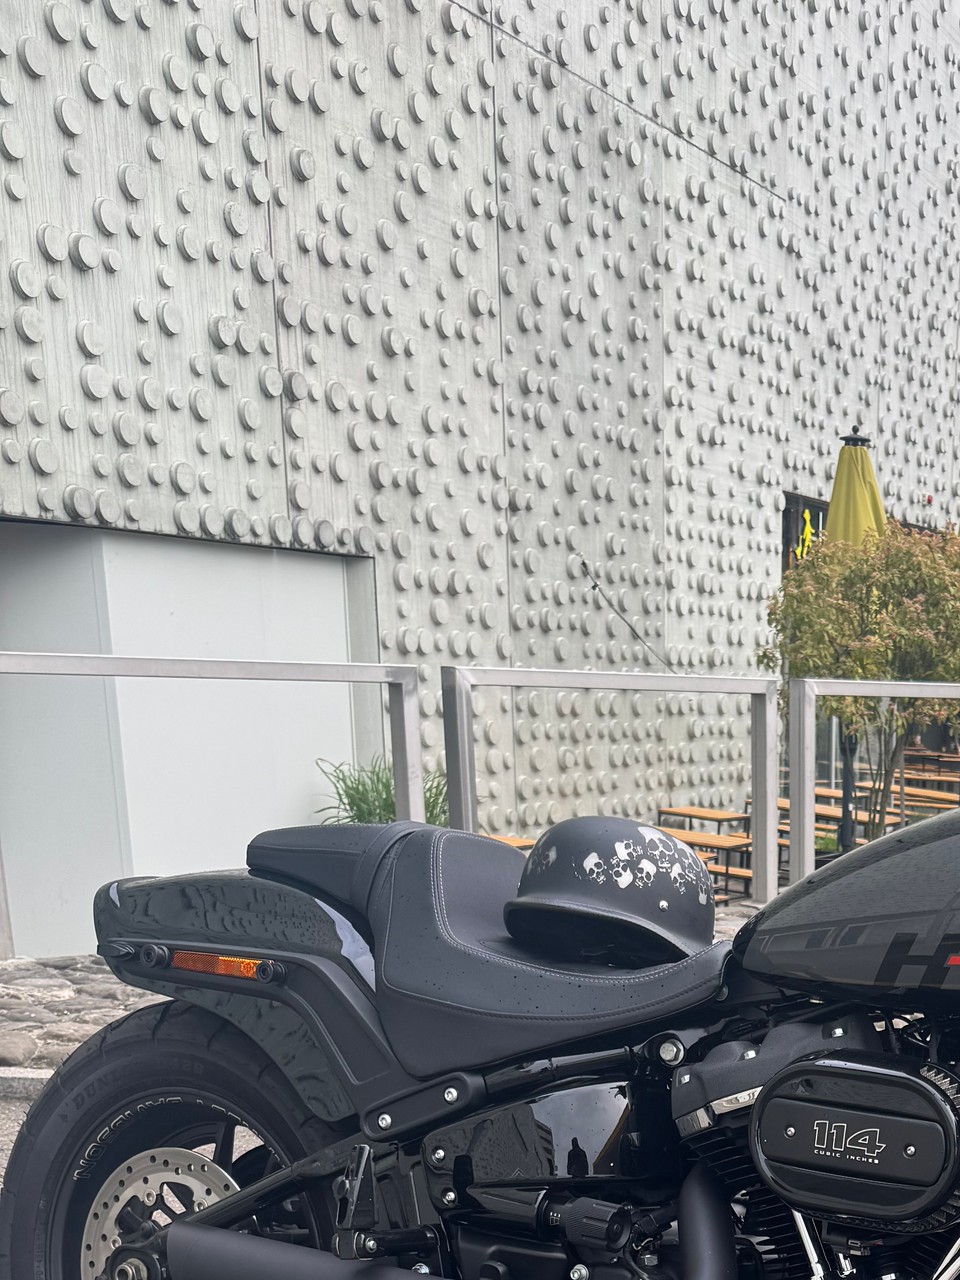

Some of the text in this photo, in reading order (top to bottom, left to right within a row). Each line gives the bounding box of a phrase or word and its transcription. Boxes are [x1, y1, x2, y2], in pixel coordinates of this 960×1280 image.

[814, 1120, 886, 1156] 114
[814, 1149, 879, 1164] CUBIC INCHES
